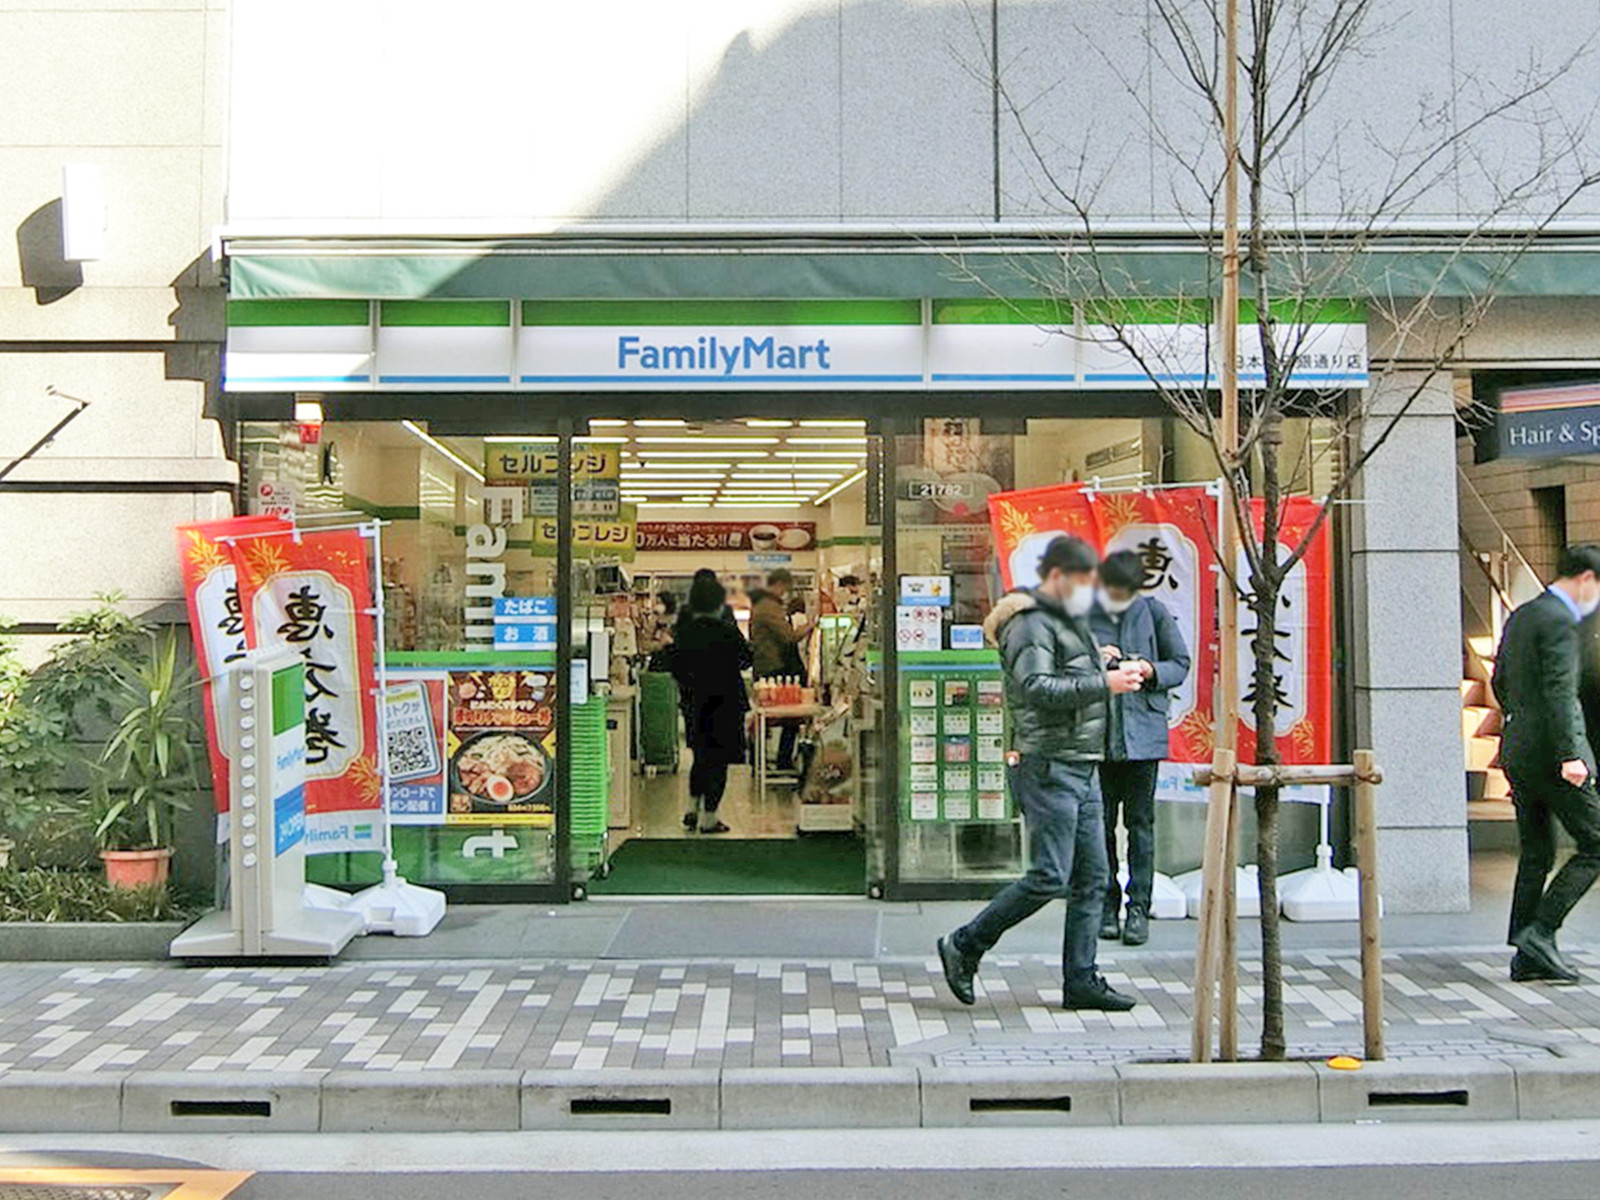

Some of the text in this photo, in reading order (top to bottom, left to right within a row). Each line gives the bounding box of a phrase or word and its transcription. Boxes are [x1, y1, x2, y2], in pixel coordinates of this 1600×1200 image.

[618, 336, 830, 374] FamilyMart
[1510, 425, 1553, 446] Hair
[1558, 422, 1574, 443] &
[919, 484, 963, 497] 21782
[541, 523, 630, 543] セフレジ
[504, 600, 548, 615] たばこ
[504, 626, 549, 641] お酒
[387, 786, 437, 798] ンロードで
